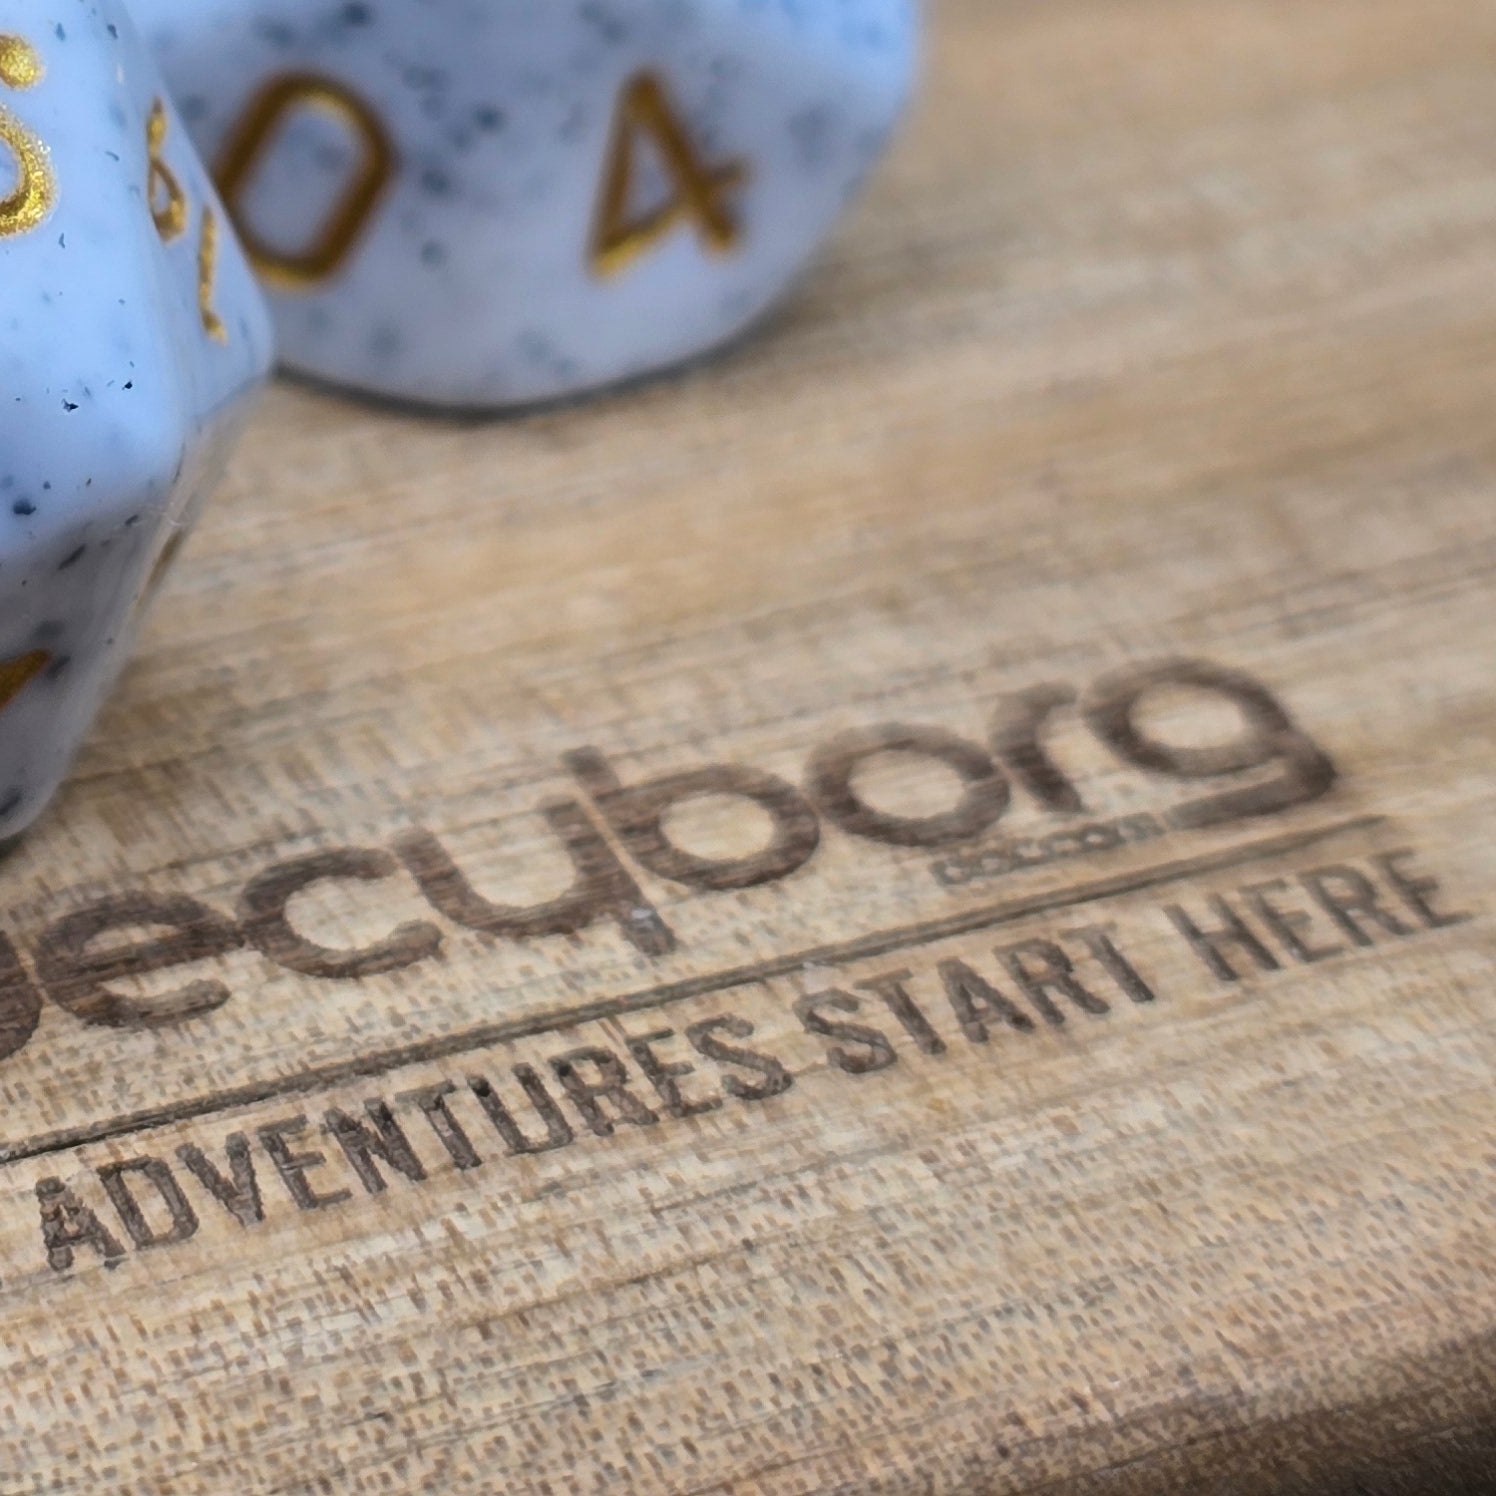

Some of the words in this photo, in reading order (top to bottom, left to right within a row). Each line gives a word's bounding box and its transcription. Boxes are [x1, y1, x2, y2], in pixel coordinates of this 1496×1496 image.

[209, 62, 401, 289] 0
[584, 62, 754, 284] 4
[34, 1012, 794, 1273] ADVENTURES
[791, 919, 1155, 1077] START
[1160, 844, 1484, 982] HERE
